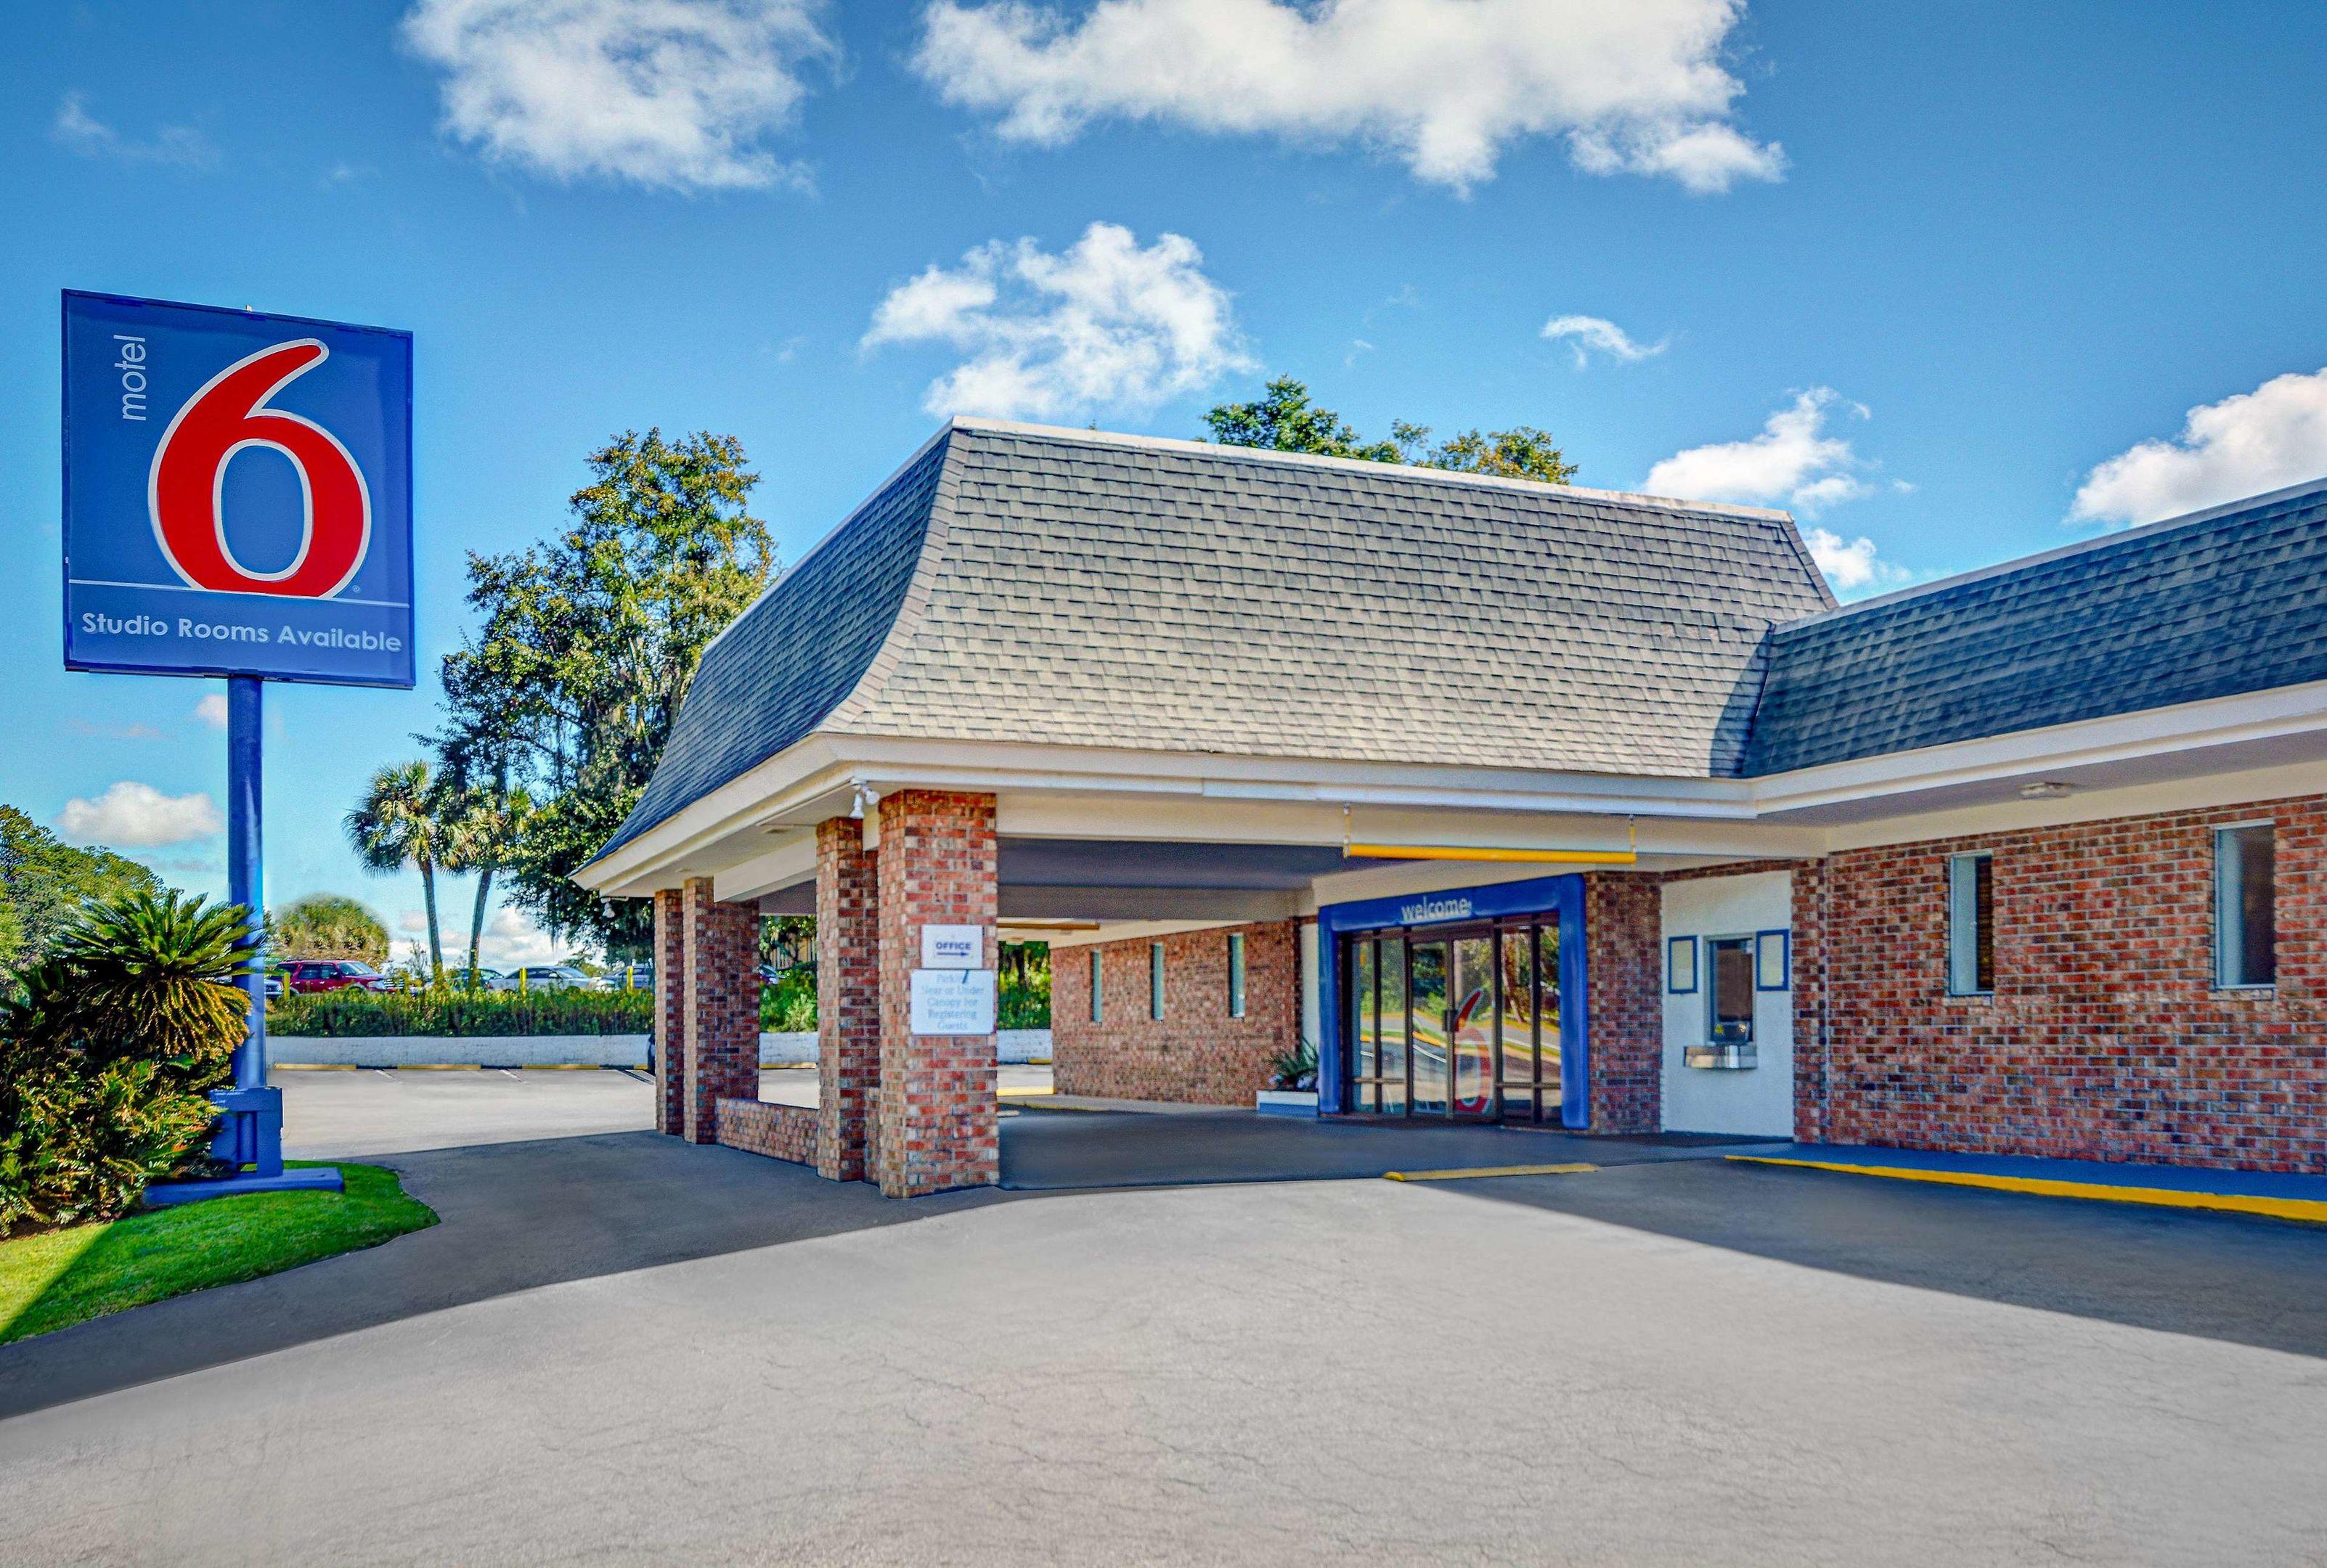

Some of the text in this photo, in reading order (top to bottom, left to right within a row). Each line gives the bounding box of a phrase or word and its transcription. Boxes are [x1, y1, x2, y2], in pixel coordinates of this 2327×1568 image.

[113, 335, 147, 421] motel
[148, 338, 372, 600] 6
[82, 612, 402, 653] Studio Rooms Available
[1401, 896, 1472, 923] welcome
[935, 942, 972, 950] OFFICE
[958, 985, 985, 995] Under
[927, 997, 961, 1008] Canopy
[928, 1008, 977, 1020] Registering
